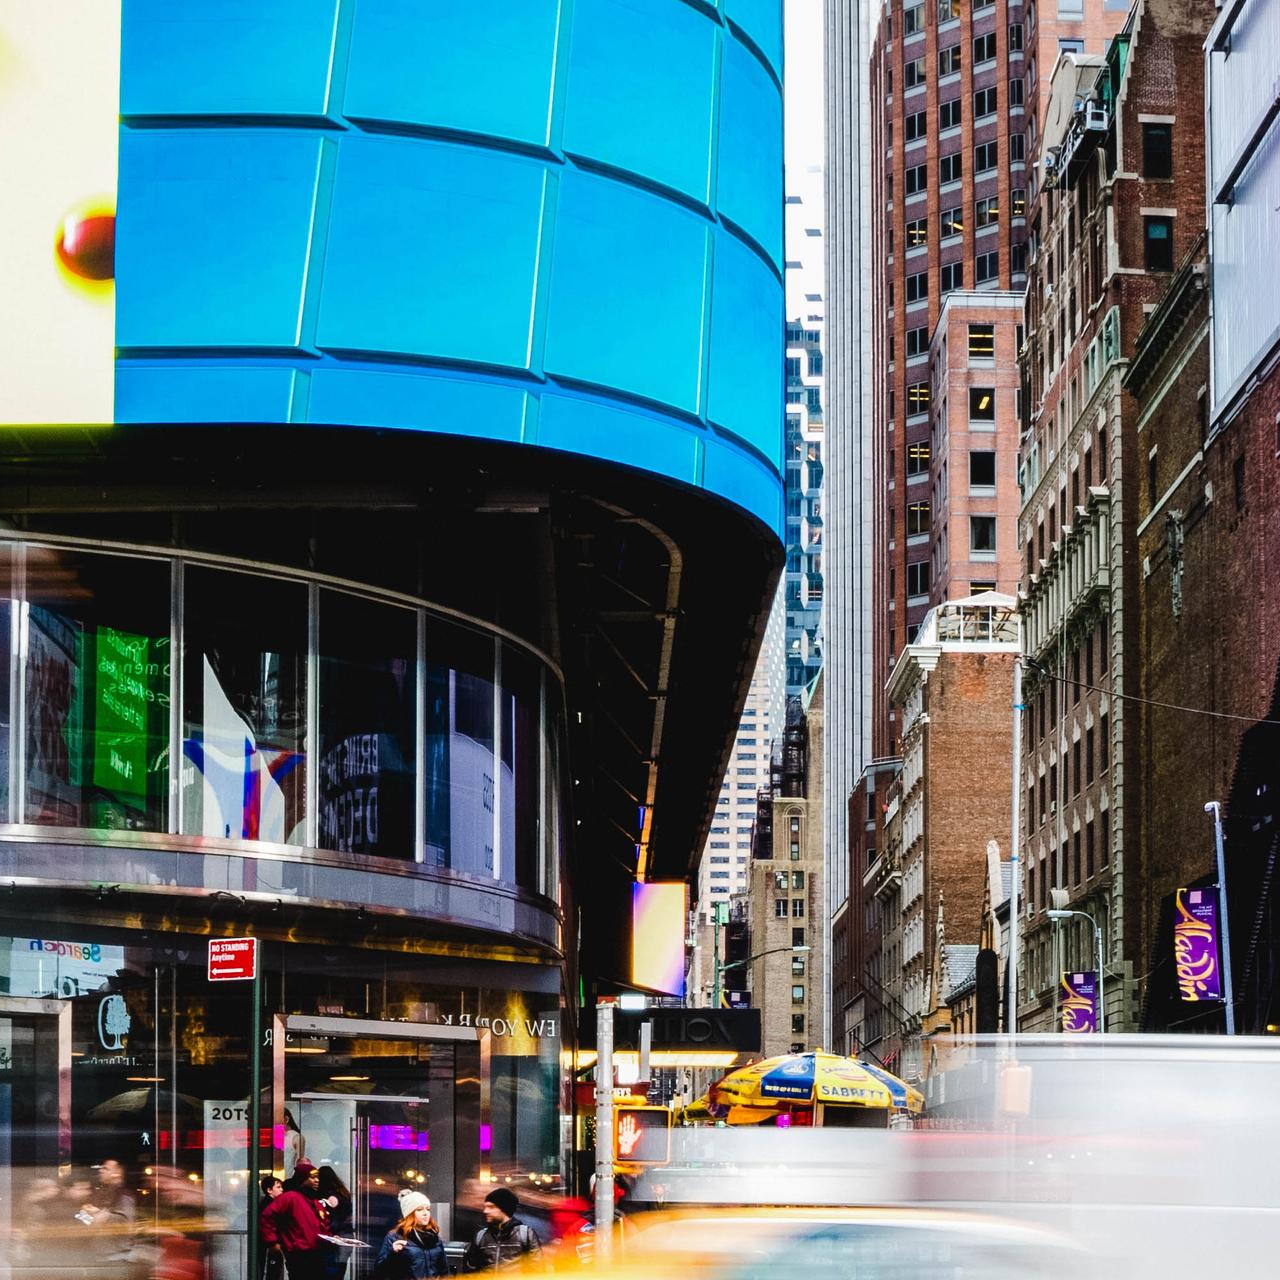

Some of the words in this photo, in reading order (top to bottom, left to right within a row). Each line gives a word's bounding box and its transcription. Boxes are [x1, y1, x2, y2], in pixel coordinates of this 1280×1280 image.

[211, 944, 220, 952] NO
[221, 943, 249, 952] STANDING
[1175, 888, 1215, 1001] Aladdin
[211, 953, 235, 963] Anytime
[822, 1086, 885, 1100] SABRETT
